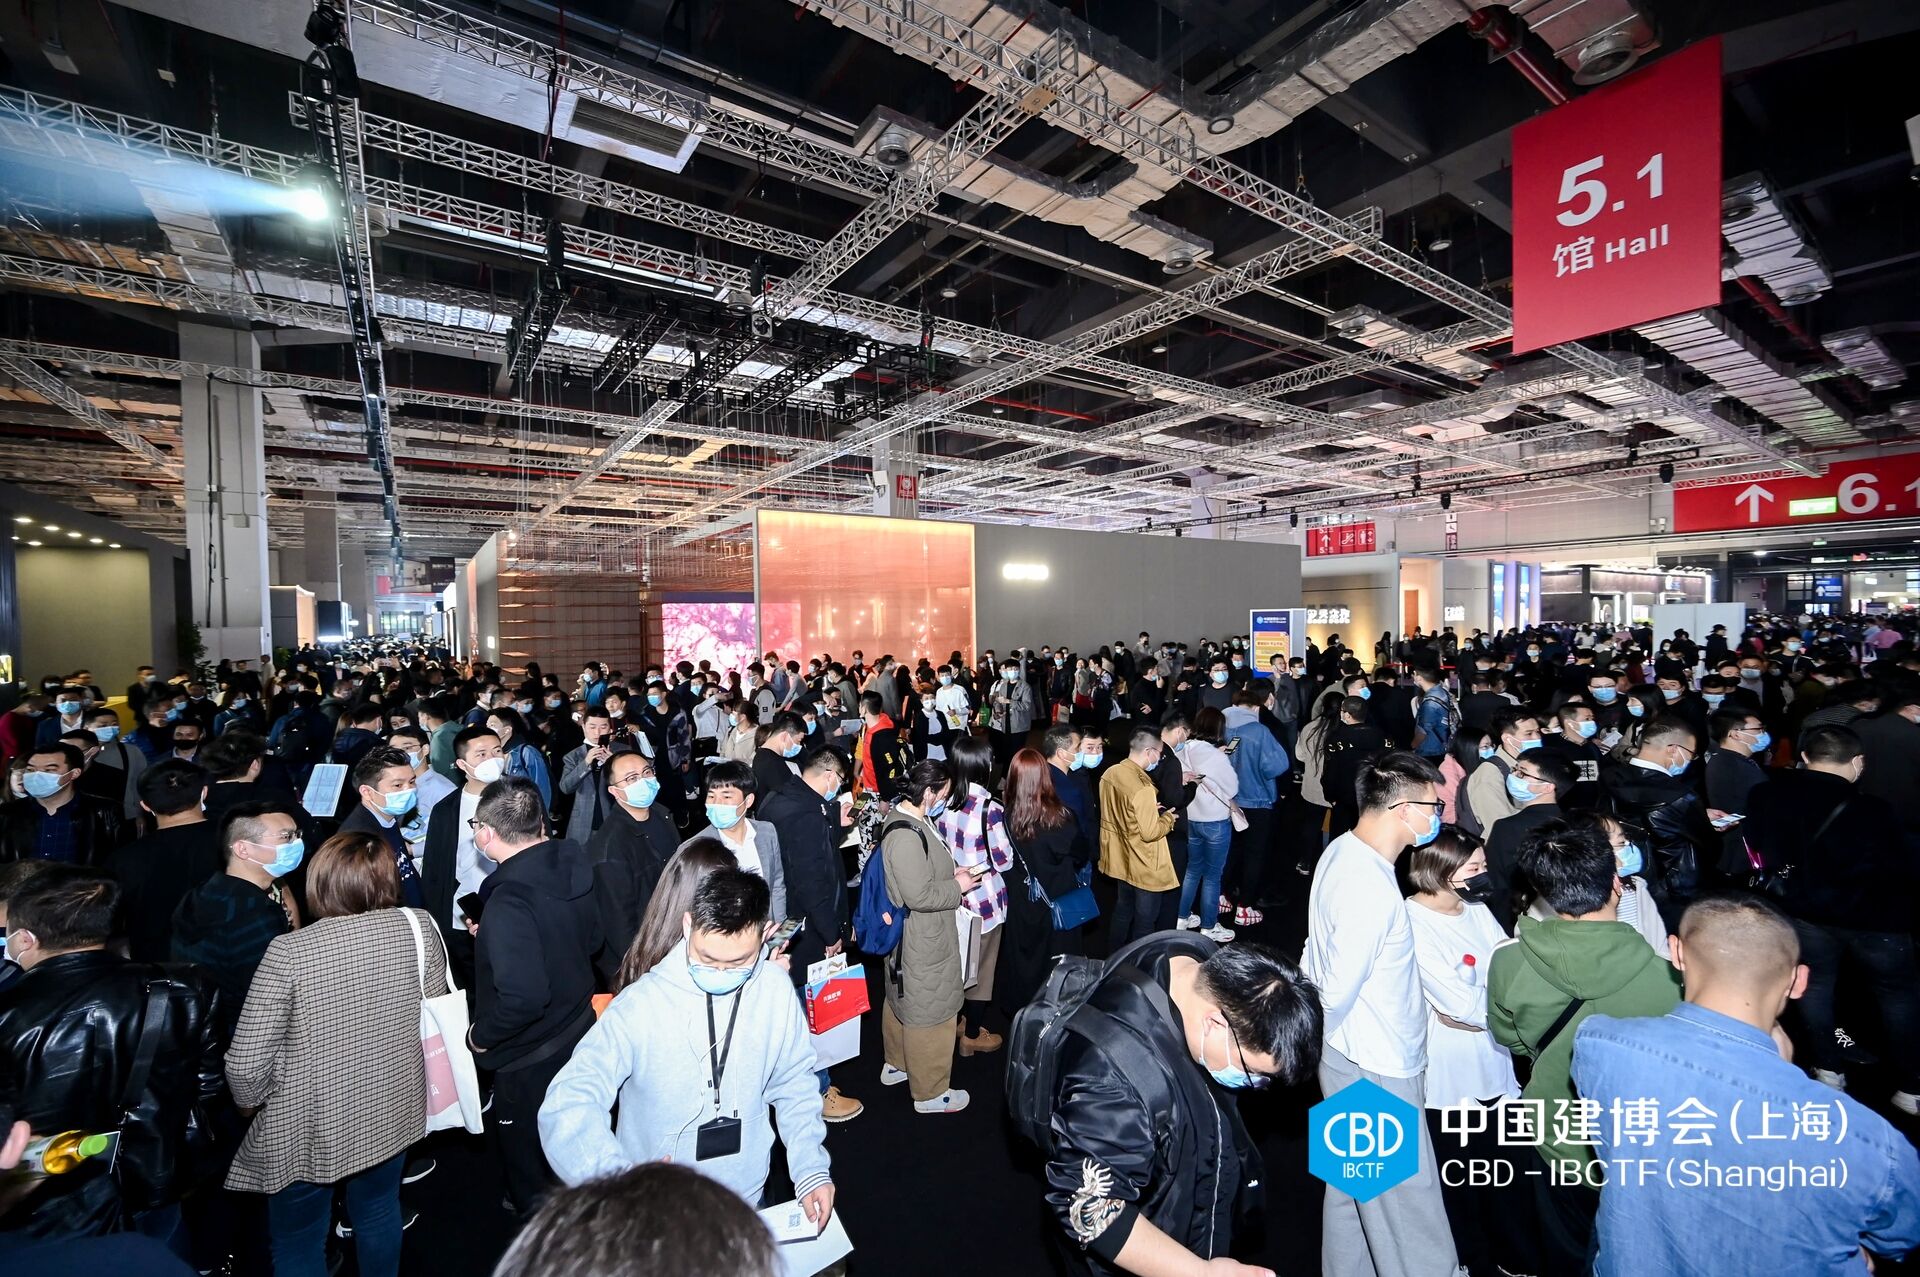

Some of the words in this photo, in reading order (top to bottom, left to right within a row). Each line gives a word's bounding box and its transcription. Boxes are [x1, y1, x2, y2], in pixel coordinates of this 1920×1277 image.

[1556, 153, 1664, 227] 5.1
[1552, 236, 1595, 278] 馆
[1605, 224, 1669, 263] Hall
